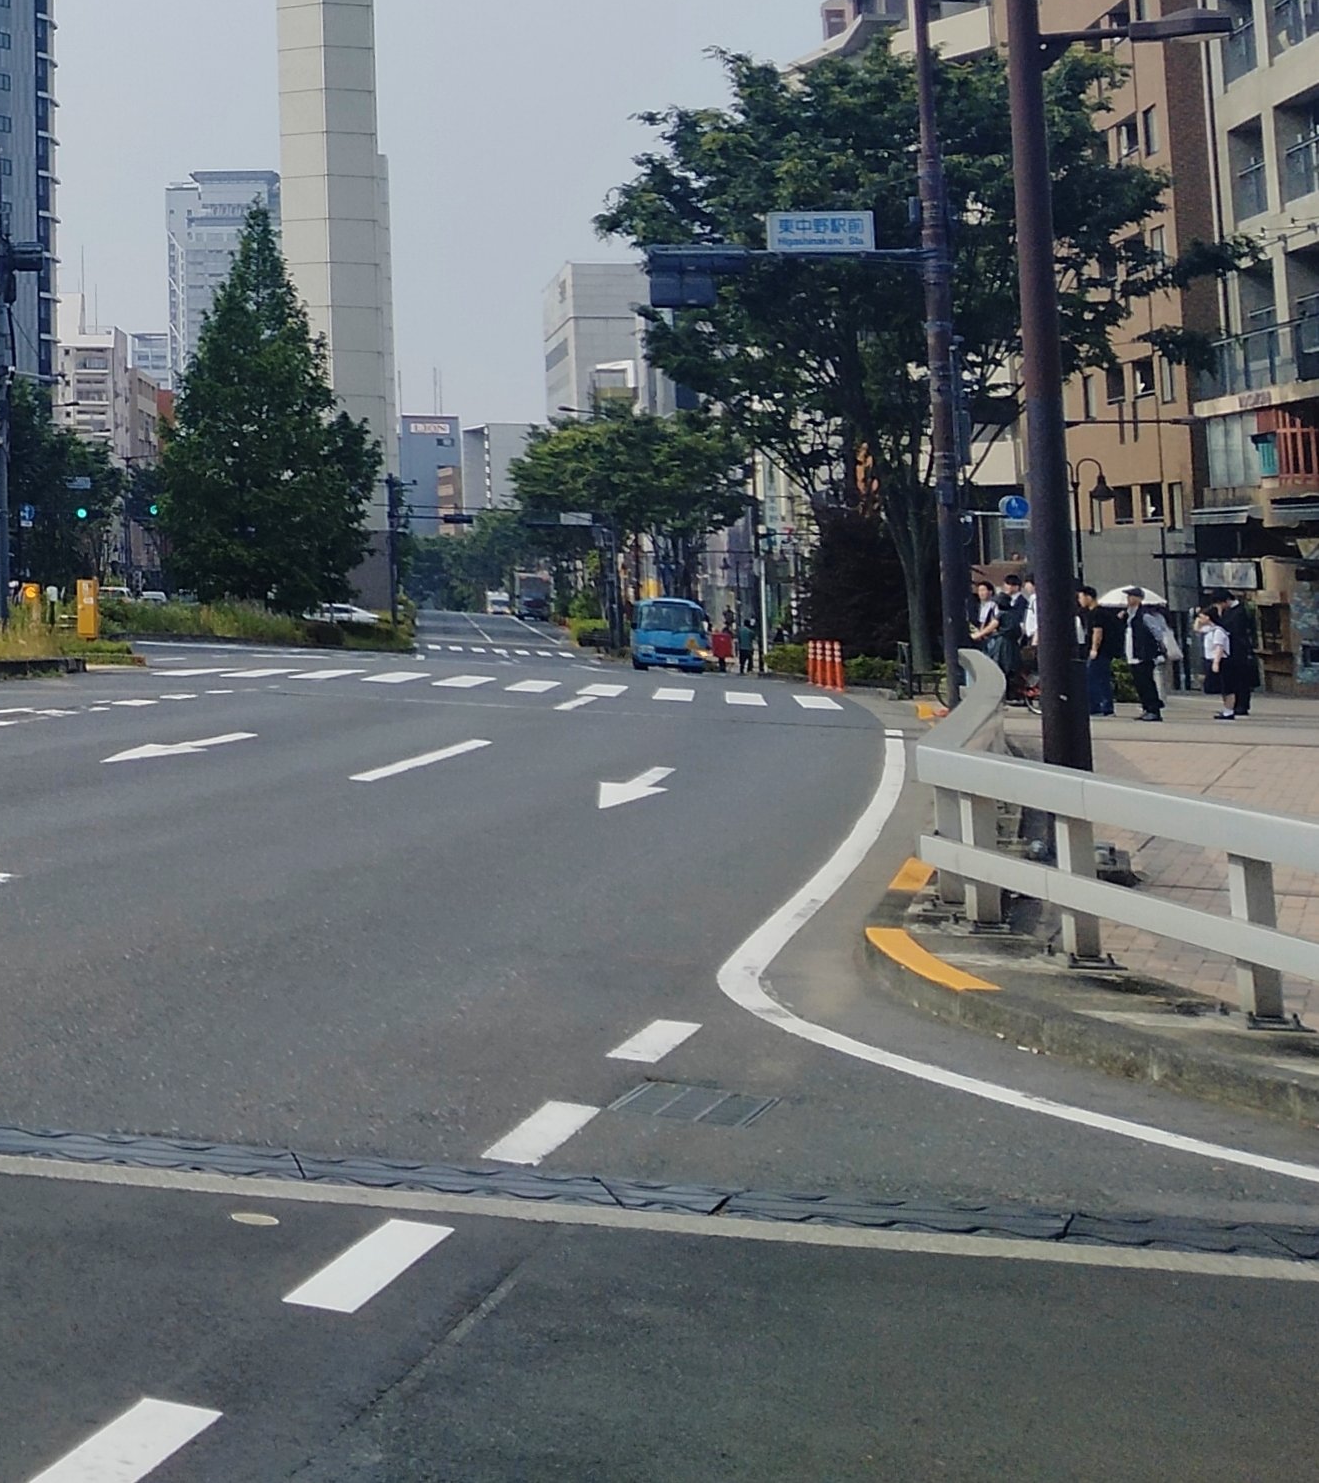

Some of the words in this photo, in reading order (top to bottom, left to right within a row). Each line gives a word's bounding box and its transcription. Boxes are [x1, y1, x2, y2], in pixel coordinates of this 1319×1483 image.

[779, 218, 864, 234] 東中野駅前
